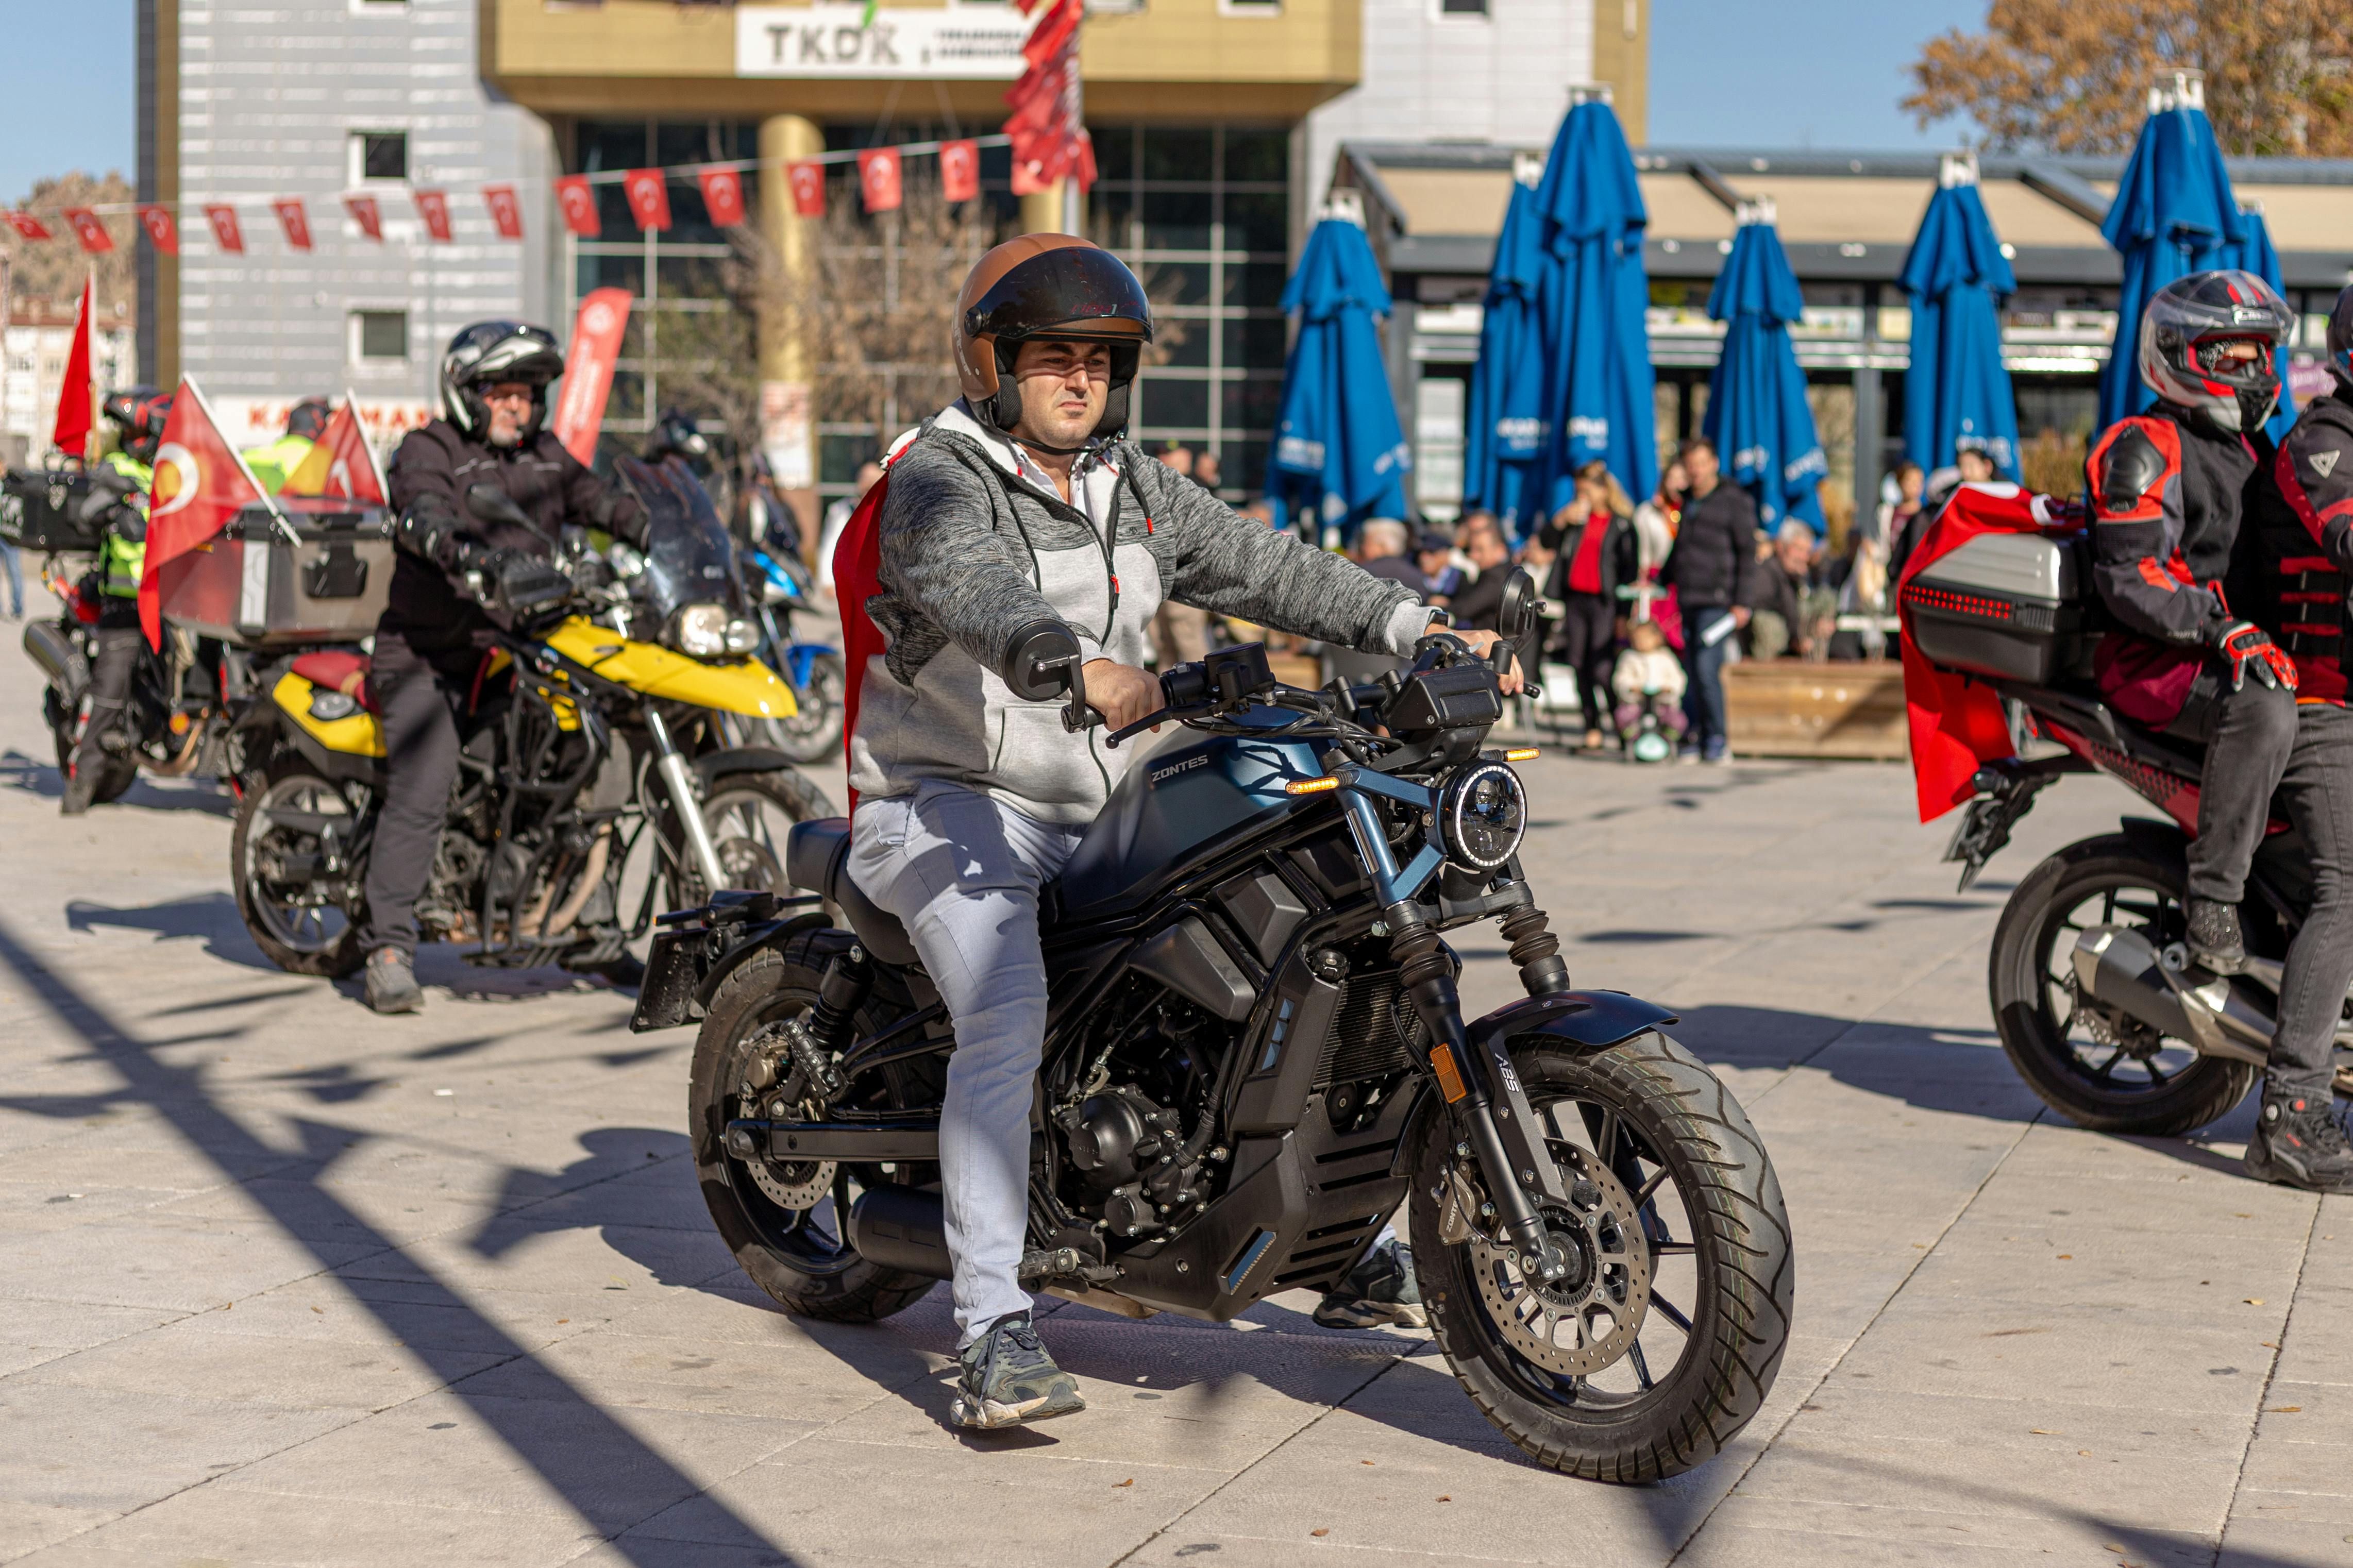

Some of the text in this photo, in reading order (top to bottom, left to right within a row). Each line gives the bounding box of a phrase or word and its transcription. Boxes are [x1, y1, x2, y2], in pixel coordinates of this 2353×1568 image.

[765, 25, 901, 64] TKDK
[1152, 755, 1208, 782] ZONTES
[1494, 1052, 1519, 1092] ABS
